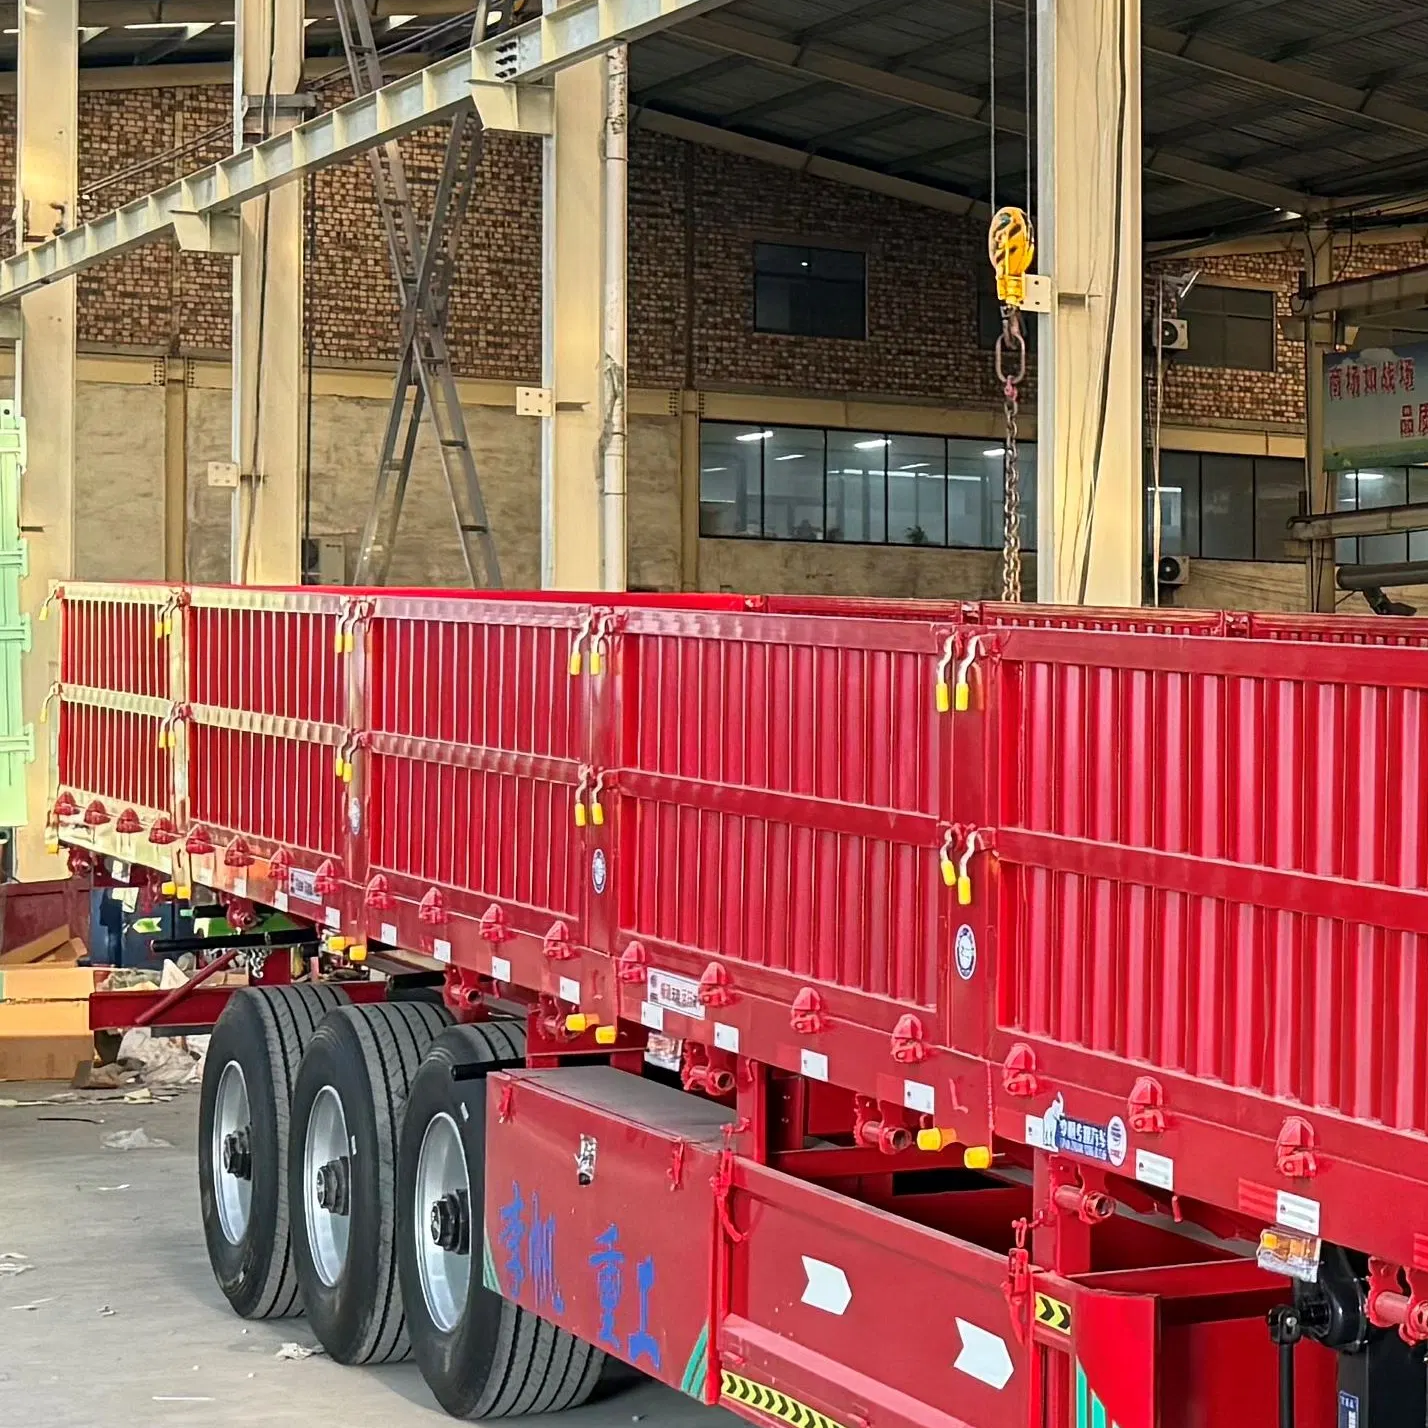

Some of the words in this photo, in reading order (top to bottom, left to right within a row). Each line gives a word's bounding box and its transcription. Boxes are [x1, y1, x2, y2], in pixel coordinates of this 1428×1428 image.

[1328, 358, 1415, 401] 商场如战场
